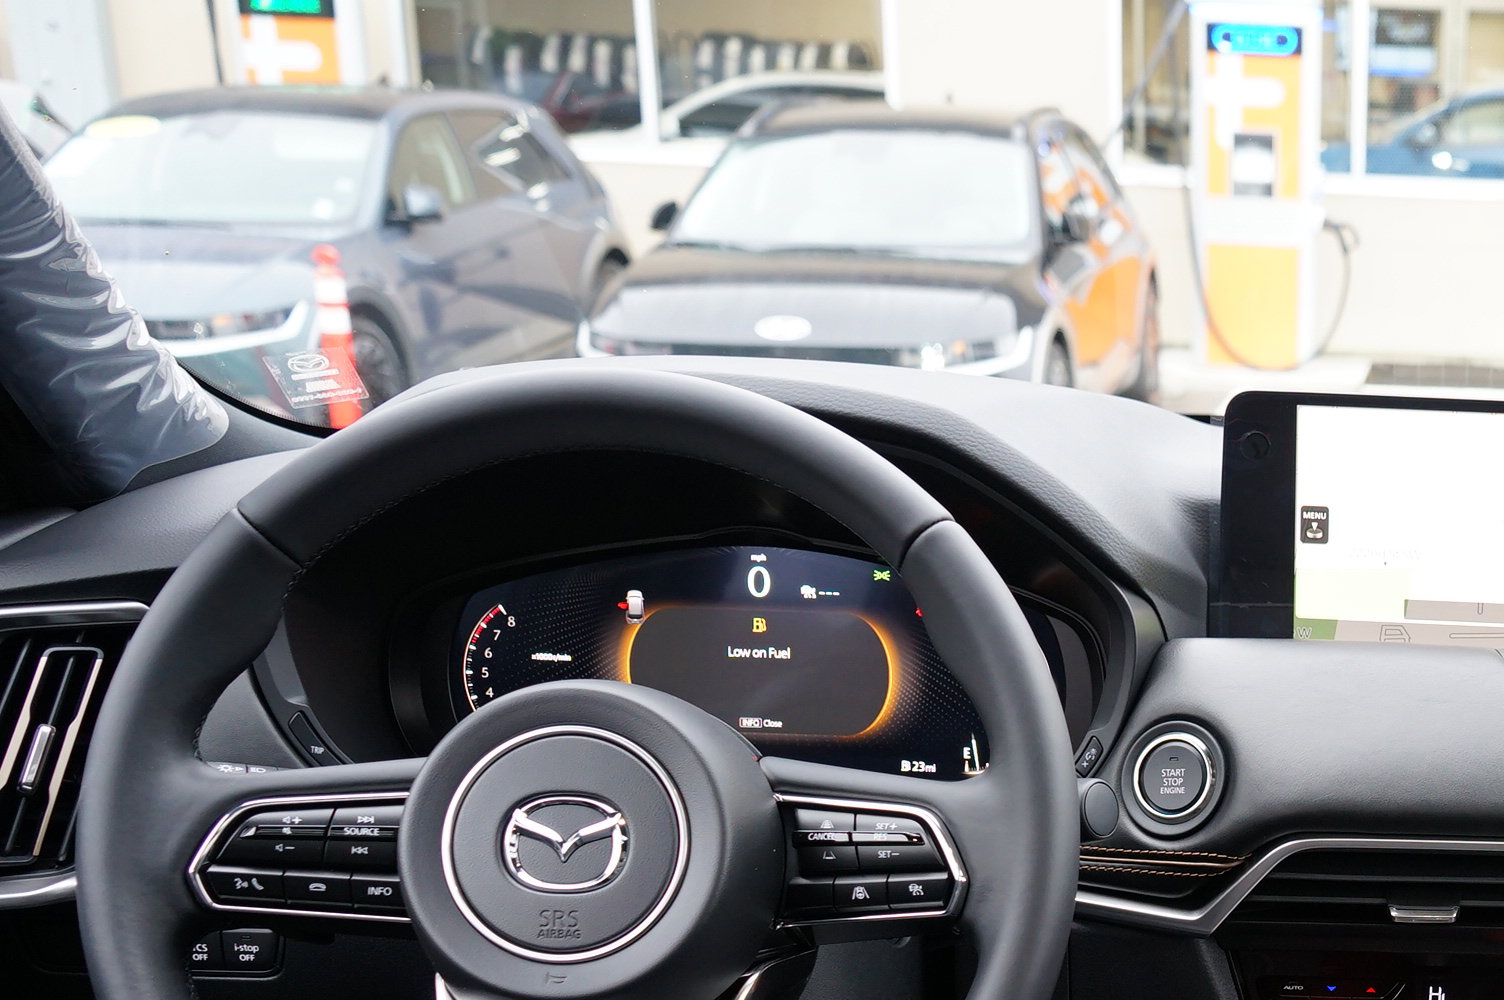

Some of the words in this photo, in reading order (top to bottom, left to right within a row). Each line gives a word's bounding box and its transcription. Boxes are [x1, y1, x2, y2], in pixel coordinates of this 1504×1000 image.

[1303, 512, 1327, 520] MENU
[750, 553, 767, 562] mph
[747, 565, 771, 598] 0
[507, 615, 516, 628] 8
[493, 629, 502, 641] 7
[484, 647, 493, 659] 6
[727, 646, 751, 658] Low
[752, 648, 767, 659] on
[768, 647, 791, 659] Fuel
[481, 666, 489, 678] 5
[485, 686, 494, 698] 4
[763, 719, 783, 728] Close
[310, 745, 325, 755] TRIP
[963, 747, 971, 759] E
[1161, 769, 1186, 777] START
[1163, 778, 1184, 787] STOP
[343, 827, 380, 836] SOURCE
[367, 886, 393, 896] INFO
[539, 909, 579, 928] SRS
[537, 929, 581, 939] AIRBAG
[234, 943, 259, 954] i-stop
[239, 954, 255, 962] OFF
